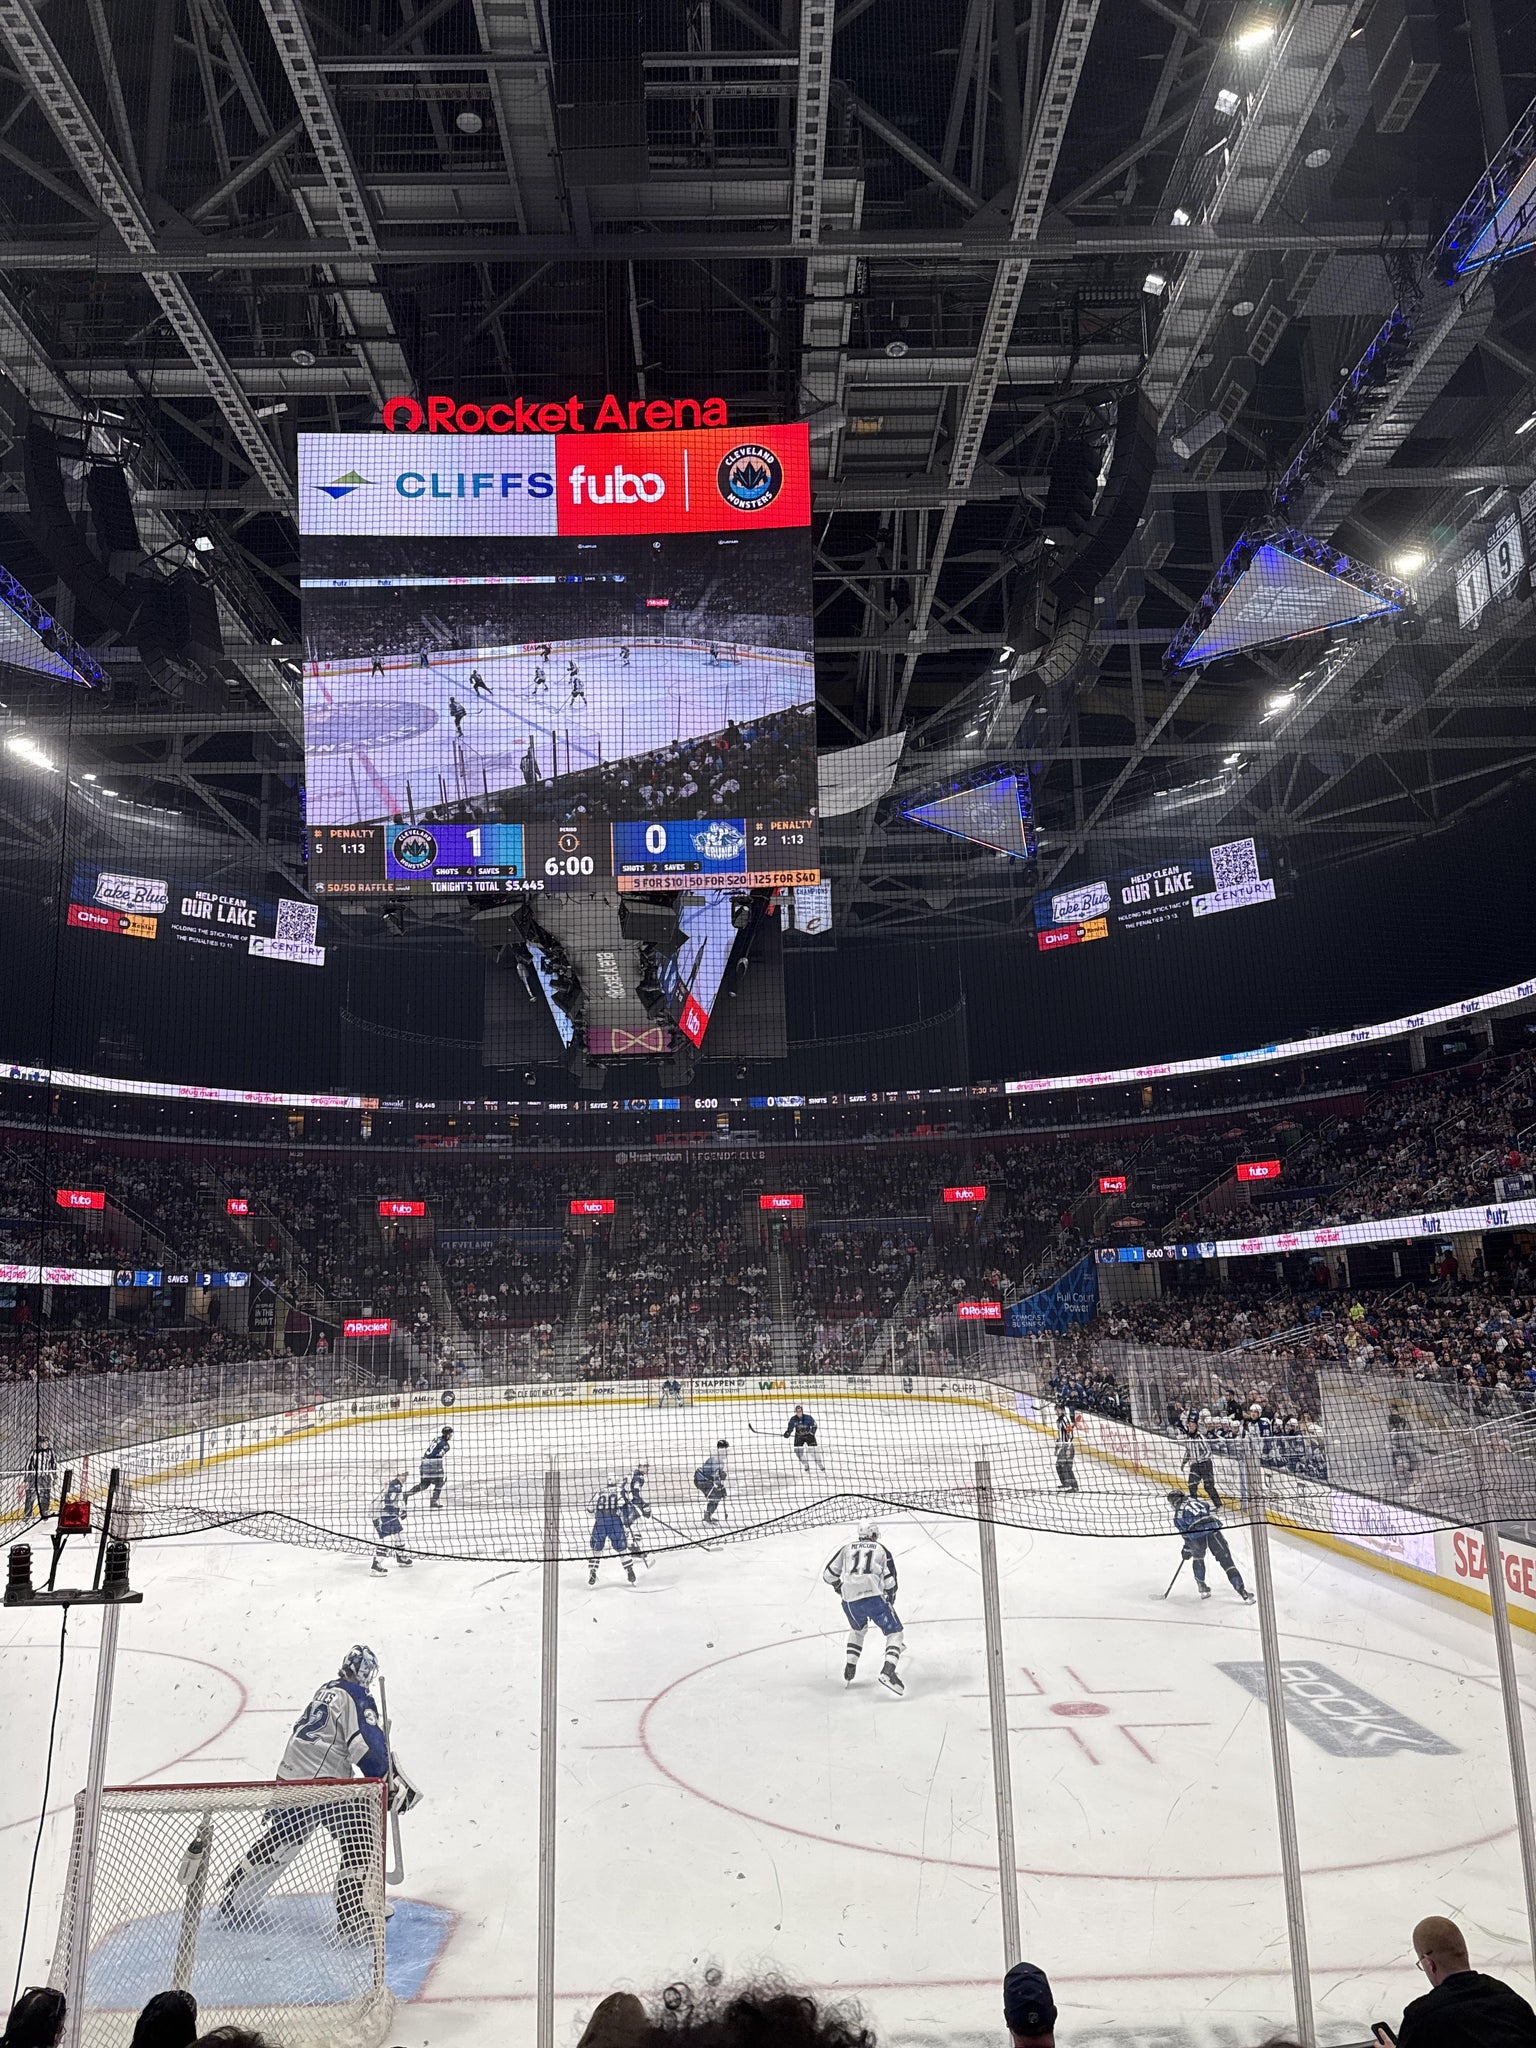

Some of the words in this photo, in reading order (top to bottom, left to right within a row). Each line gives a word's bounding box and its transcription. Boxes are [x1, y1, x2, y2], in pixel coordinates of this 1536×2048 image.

[428, 395, 584, 433] Rocket
[594, 393, 729, 431] Arena
[725, 447, 775, 466] CLEVELAND
[396, 471, 554, 499] CLIFFS
[569, 465, 665, 504] fubo
[727, 491, 773, 508] MONSTERS
[1499, 541, 1511, 579] 9
[1467, 574, 1477, 611] 1
[770, 820, 813, 831] PENALTY
[330, 829, 375, 839] PENALTY
[397, 829, 433, 842] CLEVELAND
[645, 824, 667, 855] 0
[466, 828, 481, 857] 1
[566, 839, 571, 847] 1
[753, 836, 768, 846] 22
[781, 835, 804, 846] 1:13
[315, 844, 323, 854] 5
[341, 844, 366, 854] 1:13
[705, 845, 740, 859] CRUNCH
[400, 858, 431, 870] MONSTERS
[544, 856, 594, 876] 6:00
[622, 865, 645, 873] SHOTS
[664, 863, 686, 871] SAVES
[466, 867, 472, 875] 4
[478, 867, 501, 875] SAVES
[1131, 873, 1152, 885] HELP
[1153, 866, 1179, 879] CLEAN
[633, 878, 642, 888] 5
[643, 878, 663, 888] FOR
[664, 877, 683, 888] $10
[690, 876, 703, 887] 50
[704, 876, 725, 887] FOR
[727, 875, 747, 886] $20
[754, 875, 772, 884] 125
[773, 873, 794, 884] FOR
[796, 872, 816, 883] $40
[327, 883, 356, 892] 50/50
[358, 883, 394, 892] RAFFLE
[431, 881, 473, 893] TONIGHT'S
[474, 881, 500, 892] TOTAL
[505, 880, 545, 892] $5,445
[1121, 885, 1151, 905] OUR
[1155, 871, 1194, 897] LAKE
[1214, 882, 1270, 902] CENTURY
[95, 882, 131, 900] Lake
[132, 886, 168, 905] Blue
[195, 890, 218, 902] HELP
[218, 896, 247, 908] CLEAN
[1053, 901, 1080, 920] Lake
[1082, 893, 1110, 911] Blue
[77, 911, 109, 925] Ohio
[181, 898, 213, 920] OUR
[217, 905, 258, 928] LAKE
[198, 927, 208, 935] THE
[1125, 922, 1136, 930] THE
[1045, 933, 1069, 944] Ohio
[271, 940, 322, 957] CENTURY
[972, 1087, 987, 1095] 7:30
[612, 1101, 619, 1109] 2
[694, 1098, 718, 1108] 6:00
[767, 1097, 774, 1107] 0
[832, 1096, 838, 1104] 2
[849, 1095, 867, 1103] SAVES
[871, 1093, 878, 1102] 3
[692, 1151, 737, 1161] LEGENDS
[739, 1150, 765, 1160] CLUB
[1248, 1166, 1268, 1177] fubo
[70, 1194, 91, 1205] fubo
[956, 1189, 974, 1199] fubo
[583, 1202, 602, 1213] fubo
[772, 1197, 792, 1207] fubo
[391, 1203, 412, 1214] fubo
[441, 1241, 493, 1250] CLEVELAND
[1133, 1250, 1137, 1259] 1
[1146, 1249, 1163, 1258] 6:00
[1182, 1247, 1187, 1257] 0
[147, 1274, 154, 1284] 2
[167, 1274, 189, 1283] SAVES
[203, 1274, 211, 1285] 3
[1057, 1292, 1071, 1302] Full
[1073, 1292, 1094, 1302] Court
[969, 1304, 999, 1316] Rocket
[1064, 1303, 1088, 1312] Power
[355, 1320, 388, 1333] Rocket
[759, 1381, 786, 1390] WM
[952, 1384, 976, 1394] CLIFFS
[850, 1550, 874, 1574] 11
